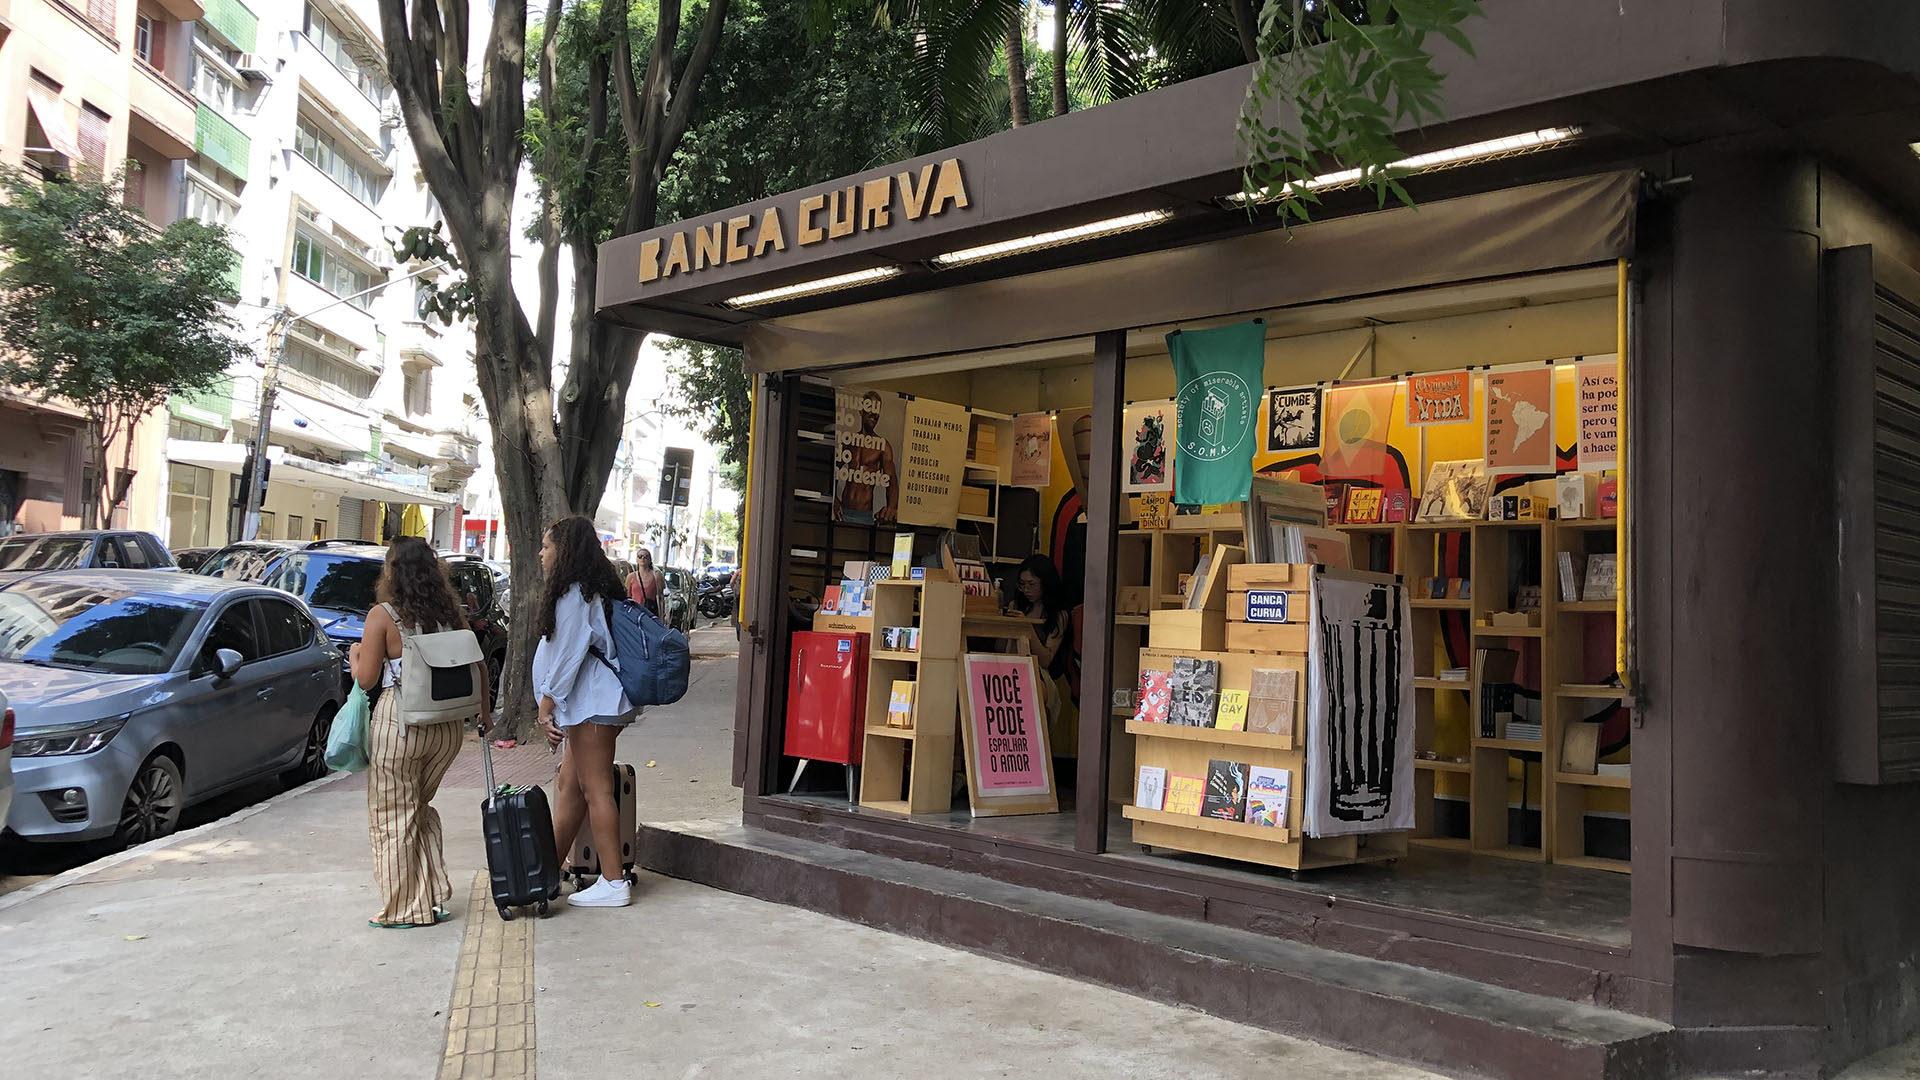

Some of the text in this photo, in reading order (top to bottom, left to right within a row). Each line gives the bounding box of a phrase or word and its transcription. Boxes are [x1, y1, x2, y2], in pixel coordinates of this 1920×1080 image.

[638, 158, 969, 283] BANCA CURVA
[1190, 384, 1200, 394] of
[1203, 377, 1240, 391] miserable
[1582, 376, 1618, 387] Así es,
[1278, 394, 1311, 408] CUMBE
[1582, 390, 1595, 400] ha
[1415, 393, 1464, 421] VIDA
[1582, 402, 1618, 414] ser me
[913, 416, 964, 433] TRABAJAR MENOS.
[1582, 417, 1607, 429] pero
[912, 429, 941, 441] TRABAJAR
[1583, 430, 1617, 440] le vam
[911, 442, 930, 454] TODOS.
[1583, 445, 1589, 453] a
[909, 455, 939, 468] PRODUCIR
[836, 465, 891, 488] nordeste
[907, 482, 949, 495] REDISTRIBUIR
[1250, 594, 1283, 605] BANCA
[1250, 607, 1282, 618] CURVA
[982, 668, 1022, 704] VOCÊ
[1222, 693, 1241, 703] KIT
[1220, 703, 1243, 714] GAY
[985, 706, 1026, 735] PODE
[989, 737, 1028, 752] ESPALHAR
[990, 753, 1031, 773] O AMOR
